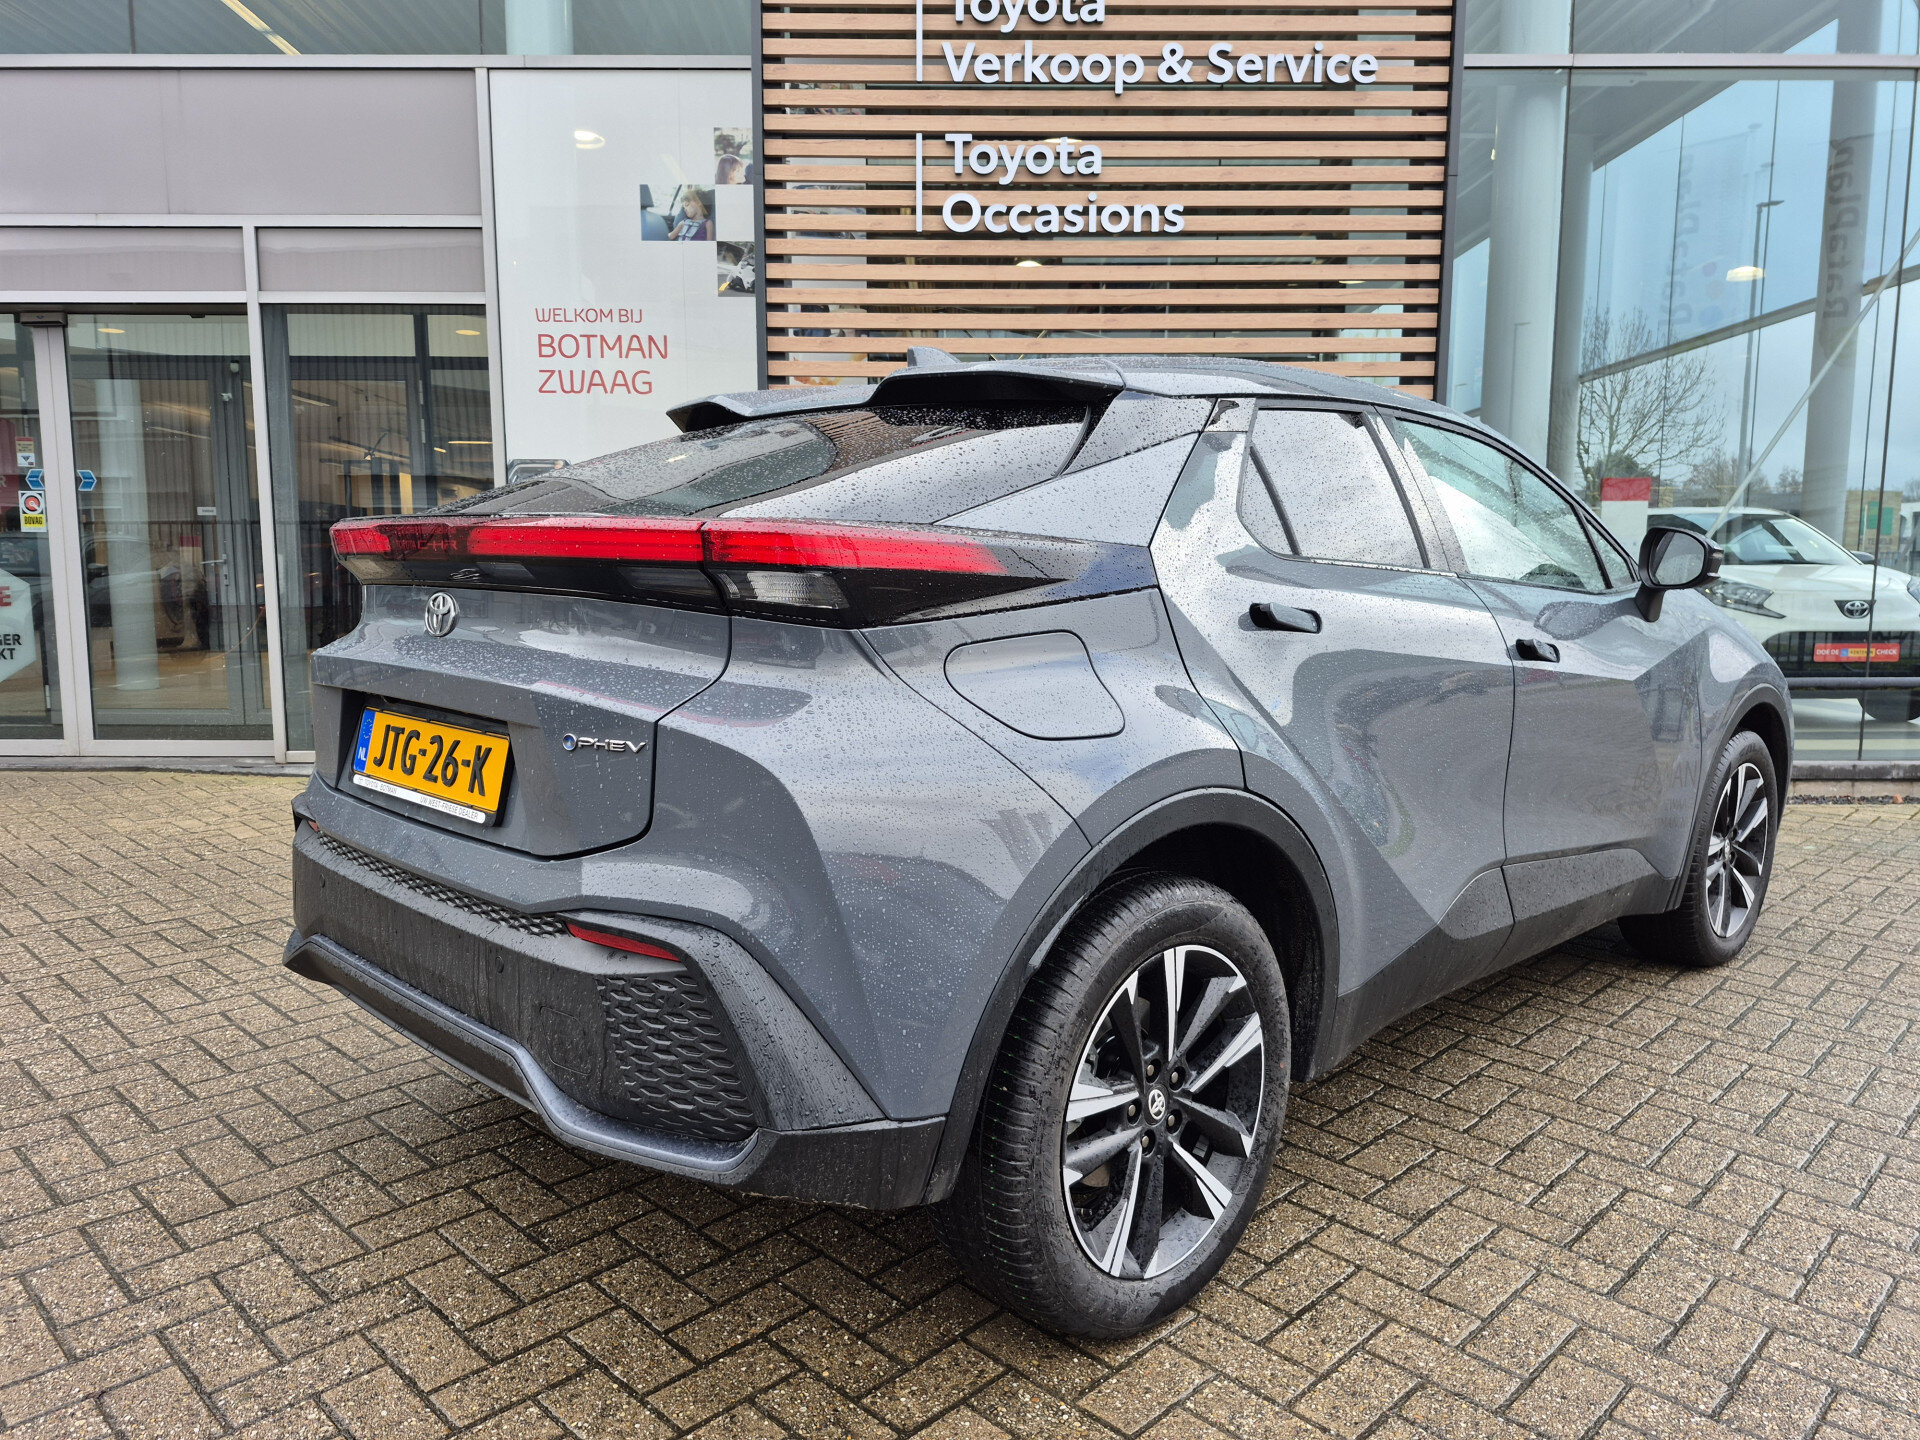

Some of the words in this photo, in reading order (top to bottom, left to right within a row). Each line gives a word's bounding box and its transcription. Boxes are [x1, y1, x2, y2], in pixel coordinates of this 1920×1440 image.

[941, 39, 1145, 96] Verkoop
[1157, 42, 1194, 84] &
[1206, 41, 1379, 84] Service
[944, 133, 1103, 185] Toyota
[942, 191, 1186, 233] Occasions
[535, 307, 613, 323] WELKOM
[618, 308, 643, 324] BIJ
[537, 333, 668, 360] BOTMAN
[537, 369, 653, 395] ZWAAG
[24, 516, 43, 525] BOVAG
[417, 540, 458, 551] C-HR
[0, 633, 22, 646] ER
[357, 746, 367, 761] NL
[577, 736, 646, 753] PHEV
[372, 724, 492, 797] JTG-26-K
[379, 783, 397, 794] BOTMAN
[428, 798, 458, 814] WEST-FRIESE
[458, 806, 479, 819] DEALER
